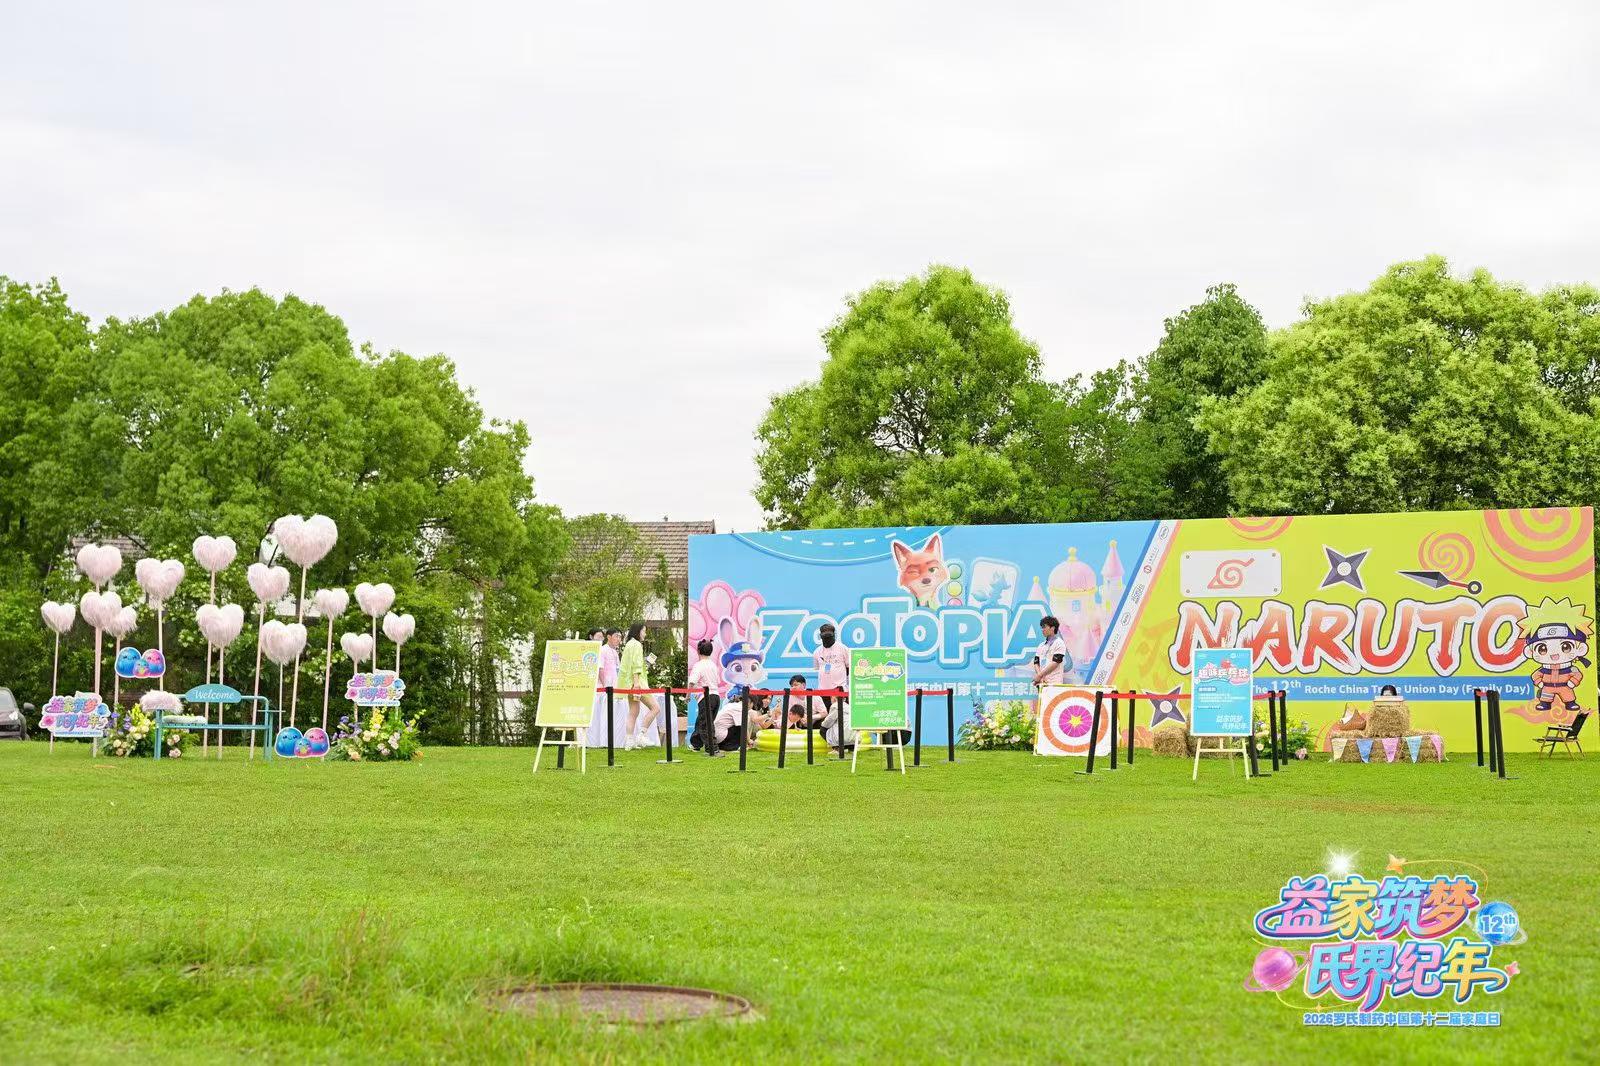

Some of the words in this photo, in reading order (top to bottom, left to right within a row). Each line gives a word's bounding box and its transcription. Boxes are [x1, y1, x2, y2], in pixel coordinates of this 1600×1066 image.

[1169, 596, 1530, 677] NARUTO
[193, 689, 234, 699] Welcome
[1271, 680, 1301, 694] 12th
[1305, 685, 1336, 694] Roche
[1339, 685, 1369, 694] China
[1371, 685, 1402, 694] Tre
[1404, 684, 1437, 694] Union
[1440, 684, 1459, 696] Day
[1505, 684, 1530, 695] Day)
